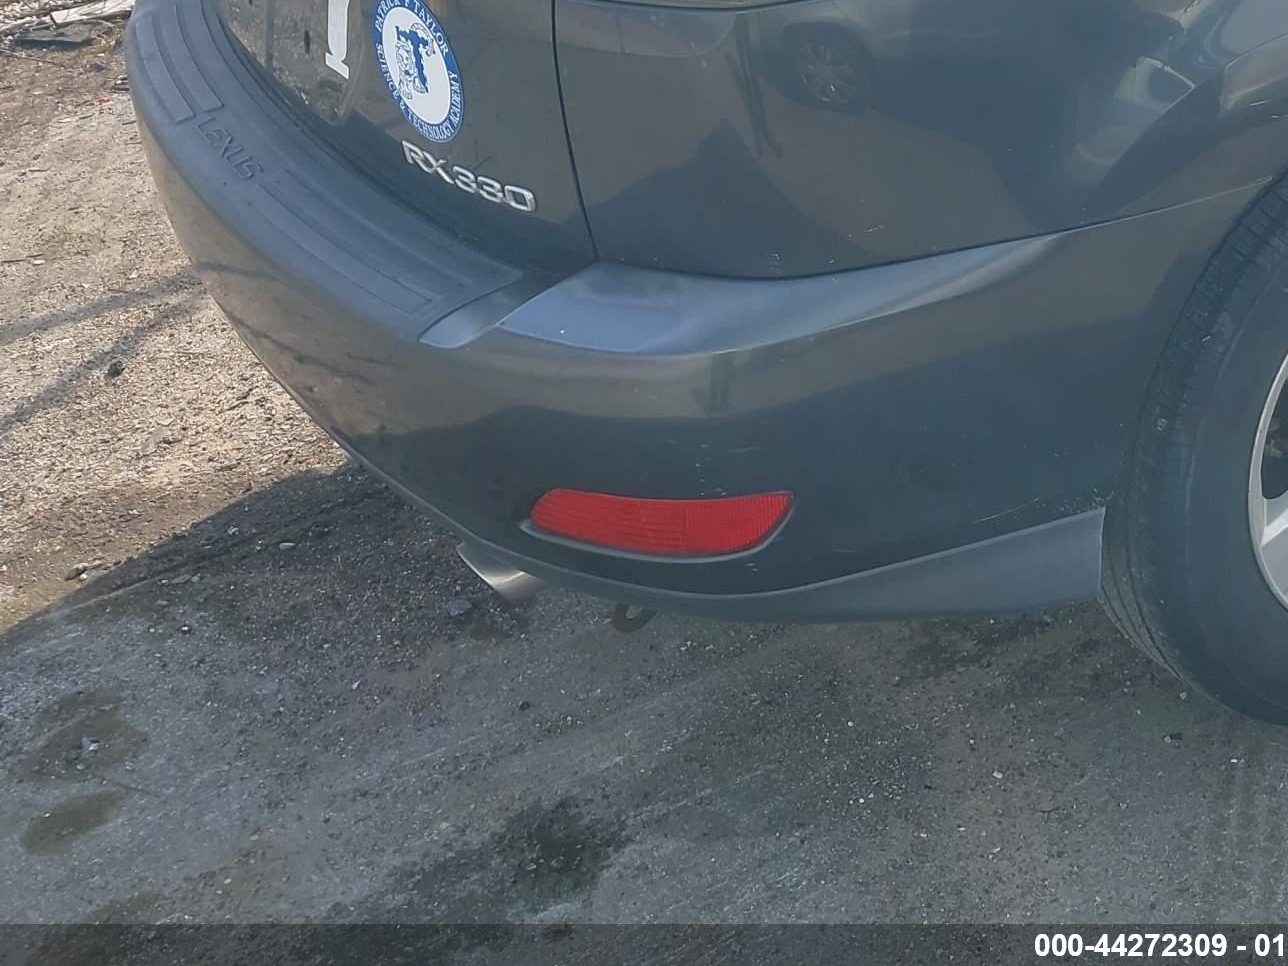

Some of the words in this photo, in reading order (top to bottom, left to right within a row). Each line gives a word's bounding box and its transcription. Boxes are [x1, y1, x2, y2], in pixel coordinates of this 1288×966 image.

[413, 0, 449, 56] TAYLOR
[375, 42, 400, 100] SCIENCE
[406, 108, 455, 140] TECHNOLOGY
[448, 70, 462, 130] ACADEMY
[194, 116, 264, 179] LEXUS
